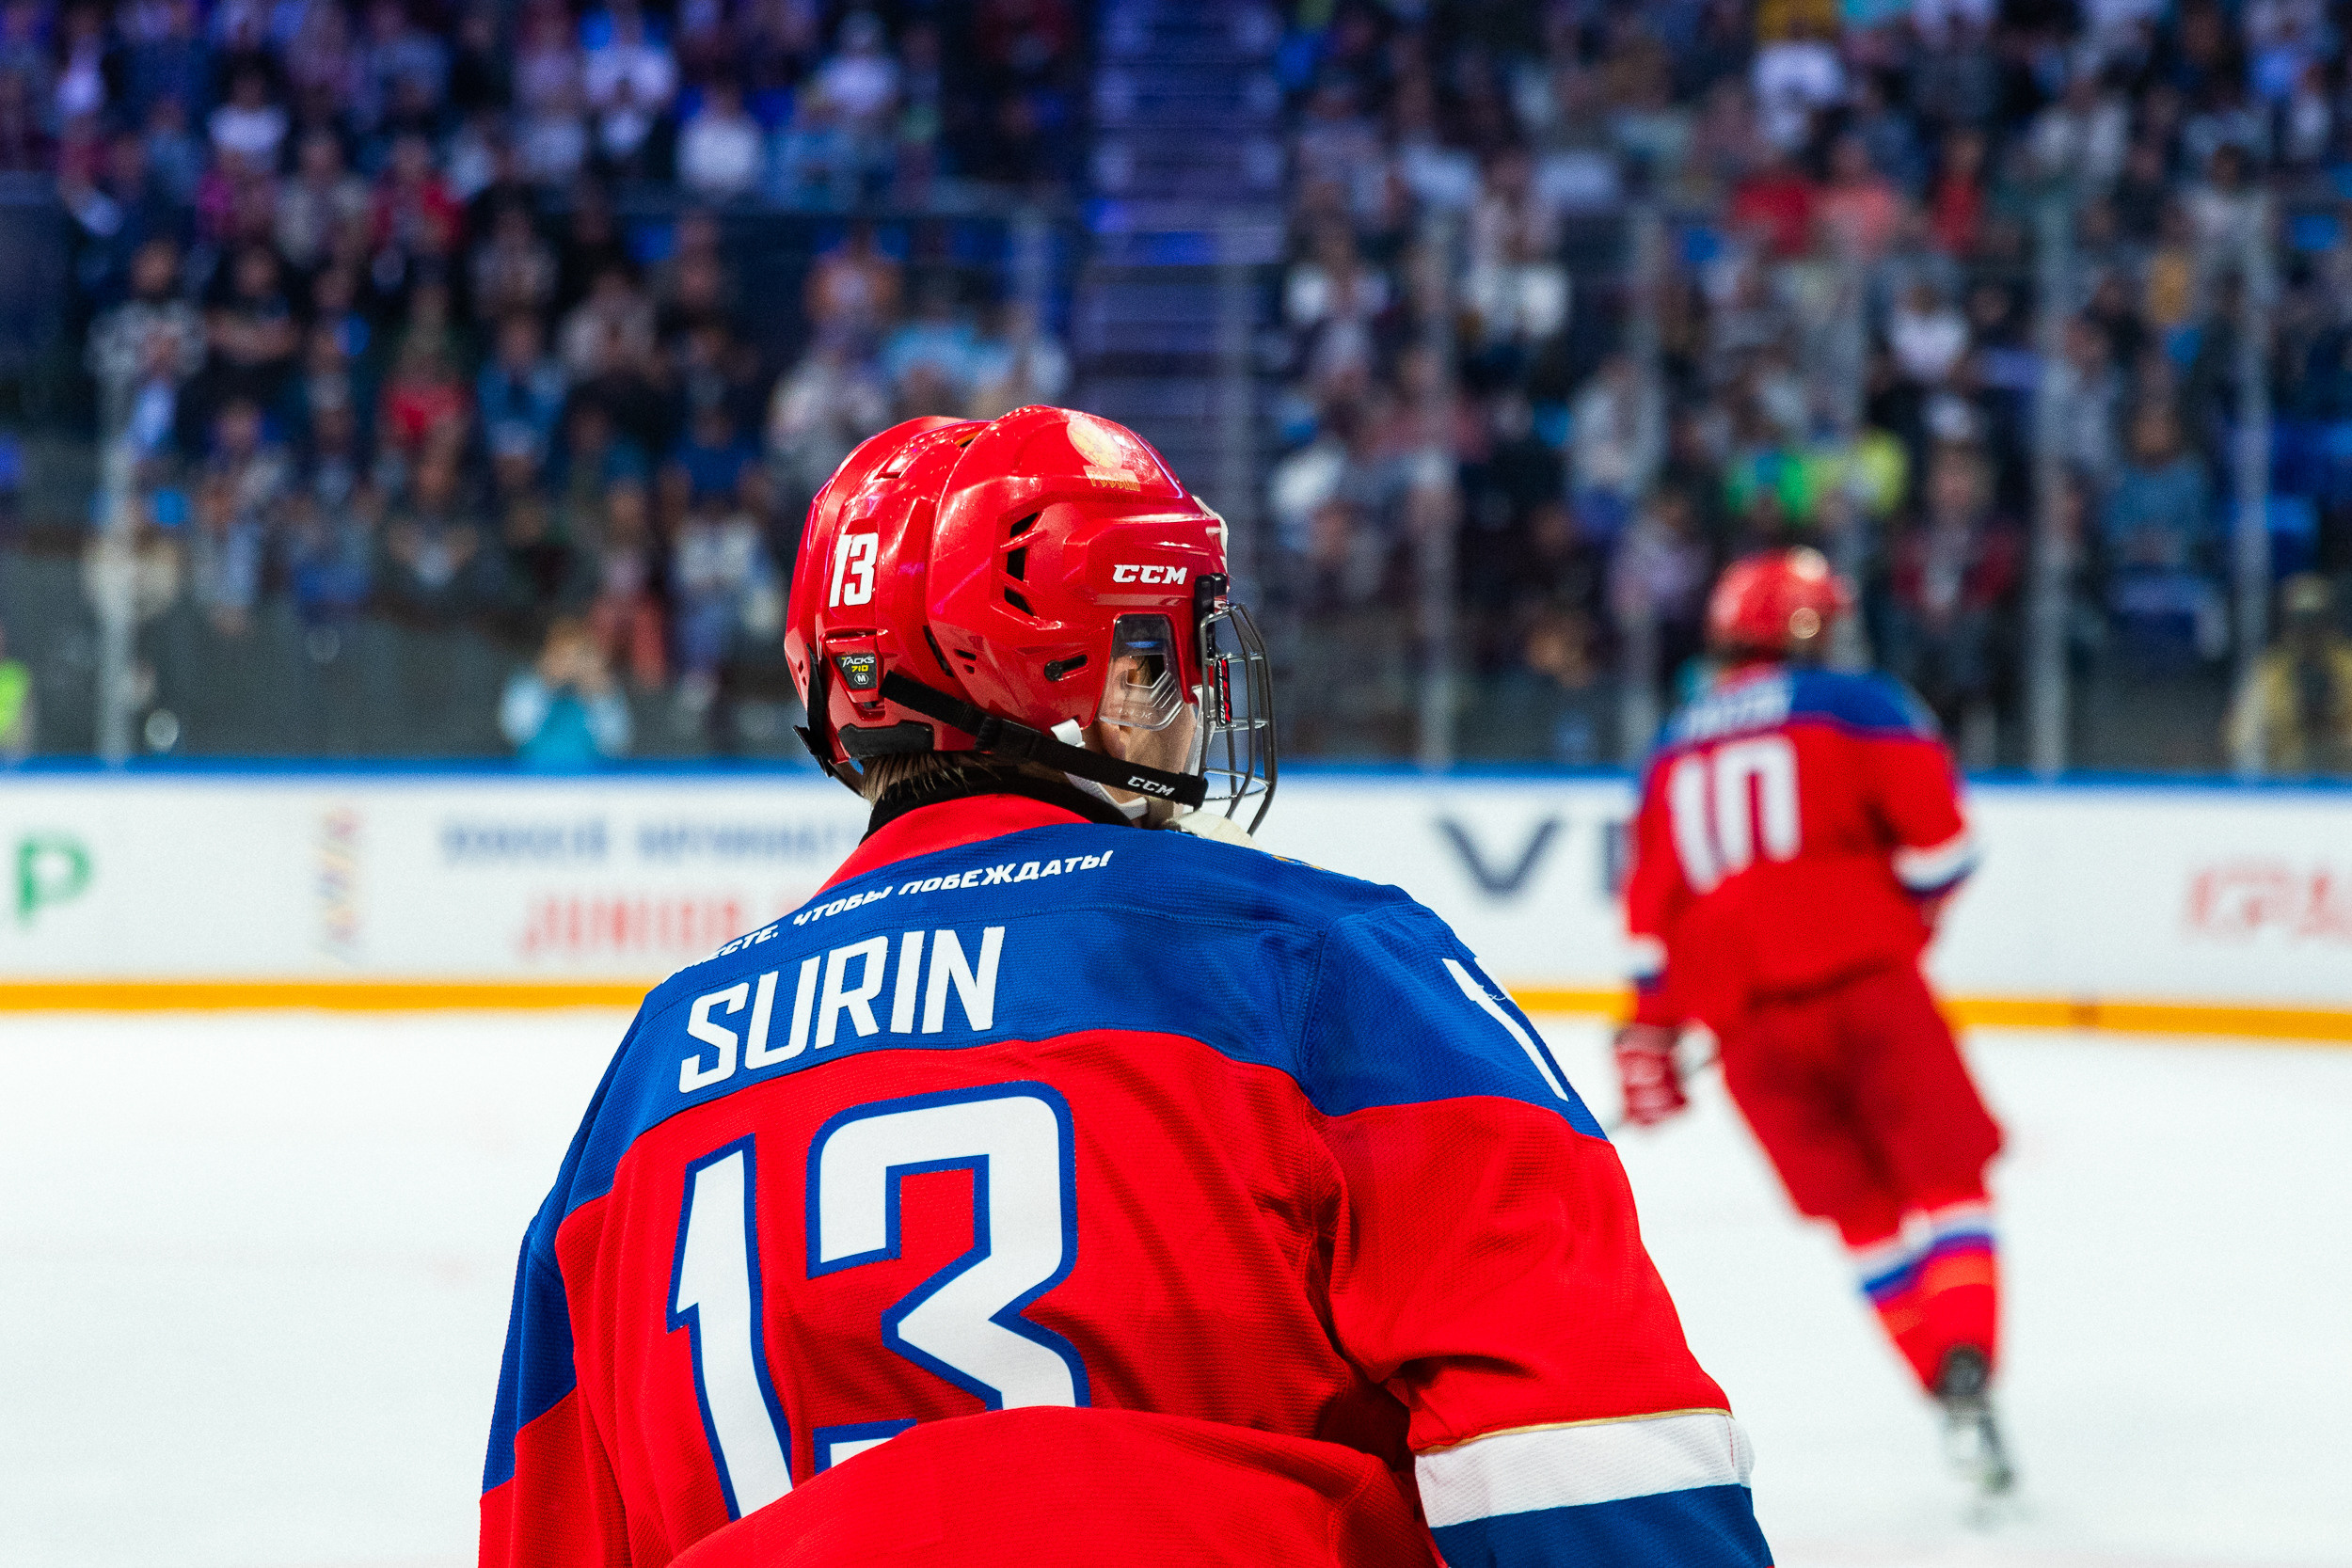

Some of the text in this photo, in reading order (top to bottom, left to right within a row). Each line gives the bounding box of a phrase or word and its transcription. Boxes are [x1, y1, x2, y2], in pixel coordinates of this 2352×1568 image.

[829, 531, 879, 608] 13
[1112, 564, 1187, 585] CCM
[841, 656, 875, 667] TACKS
[851, 664, 868, 673] 710
[1127, 776, 1175, 796] CCM
[793, 886, 893, 926] ЧТОБЫ
[898, 849, 1113, 895] ПОБЕЖДАТЬ!
[678, 927, 1005, 1093] SURIN
[666, 1080, 1091, 1523] 13
